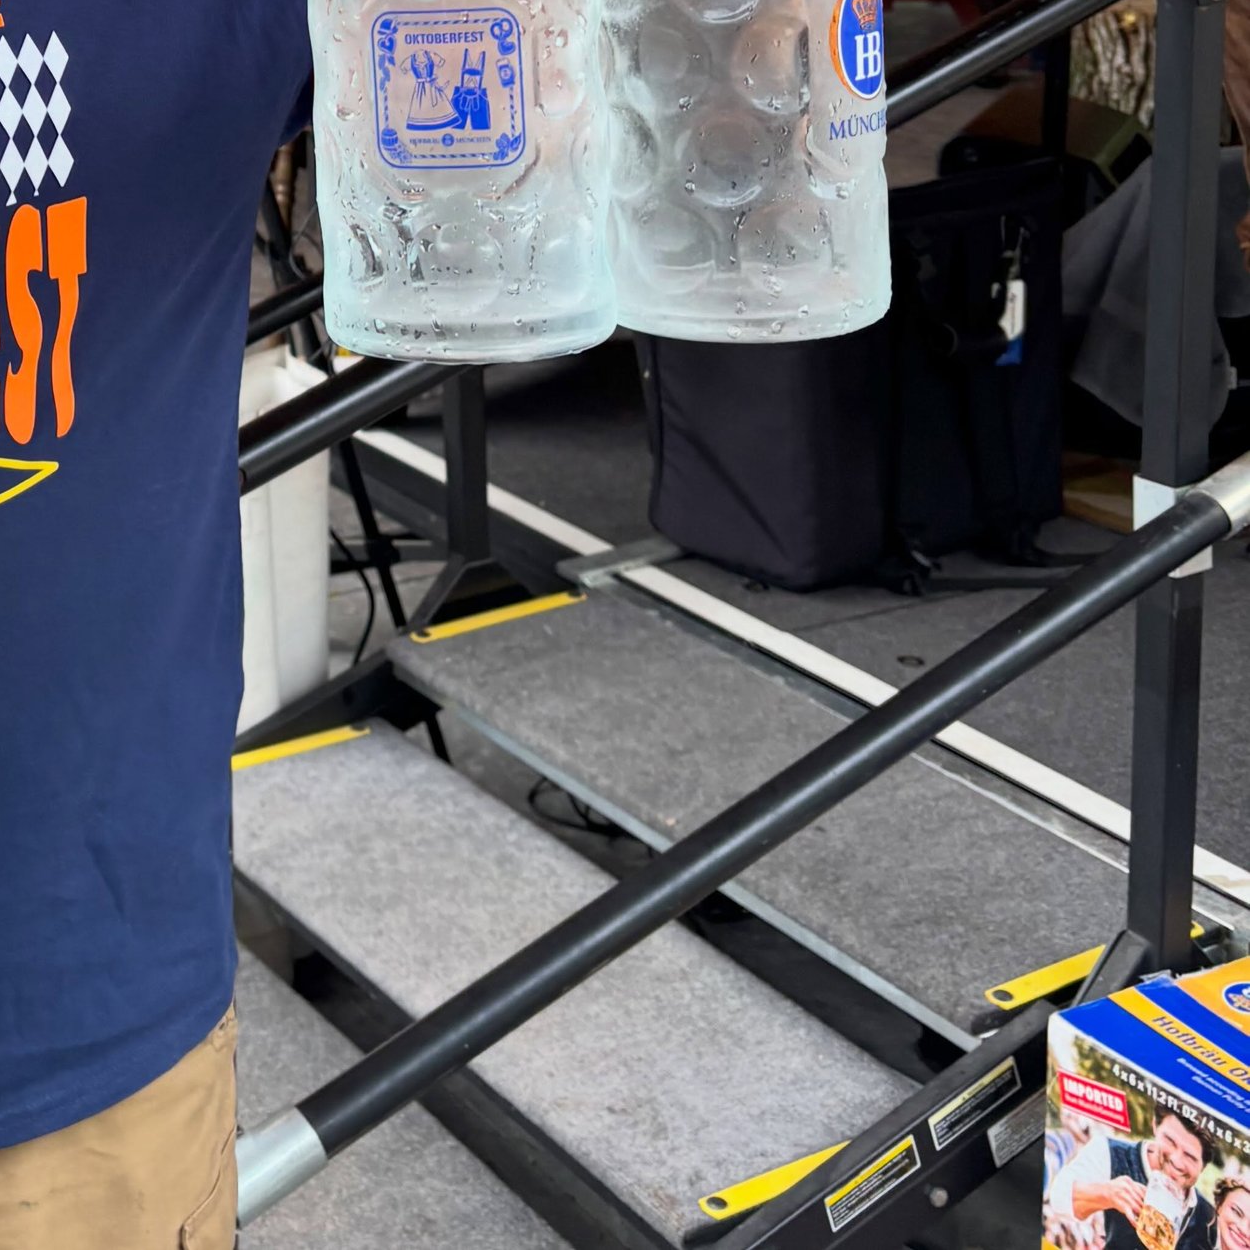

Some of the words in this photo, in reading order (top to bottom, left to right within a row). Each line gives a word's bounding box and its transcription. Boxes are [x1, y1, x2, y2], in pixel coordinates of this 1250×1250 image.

[404, 31, 485, 45] OKTOBERFEST
[854, 30, 882, 82] HB
[1152, 1016, 1227, 1066] Hofbräu
[1062, 1076, 1124, 1113] IMPORTED
